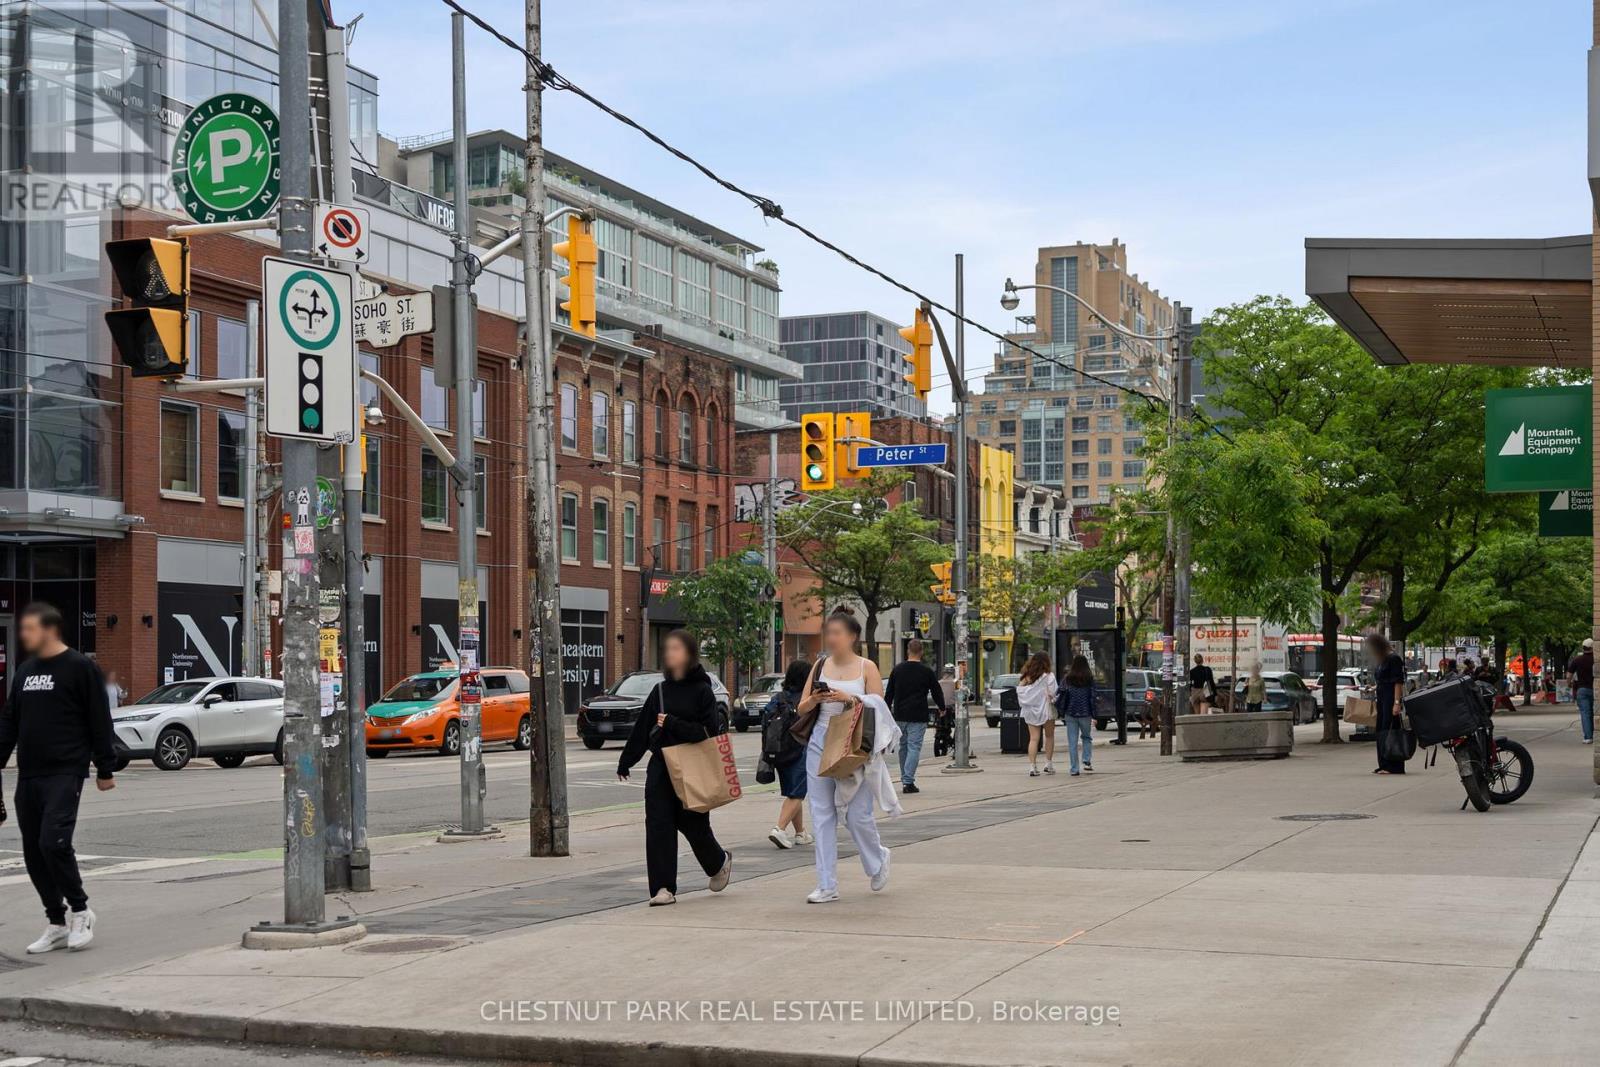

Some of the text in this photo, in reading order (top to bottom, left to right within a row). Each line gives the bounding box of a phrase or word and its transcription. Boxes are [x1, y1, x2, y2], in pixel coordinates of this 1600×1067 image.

[175, 99, 281, 165] MUNICIPAL
[209, 128, 252, 184] P
[177, 167, 281, 223] PARKING
[354, 299, 414, 320] SOHO ST.
[1527, 428, 1574, 438] Mountain
[1527, 436, 1581, 447] Equipment
[876, 446, 927, 461] Peter St
[1527, 446, 1575, 456] Company
[25, 674, 55, 686] KARL
[714, 733, 740, 800] GARAGE
